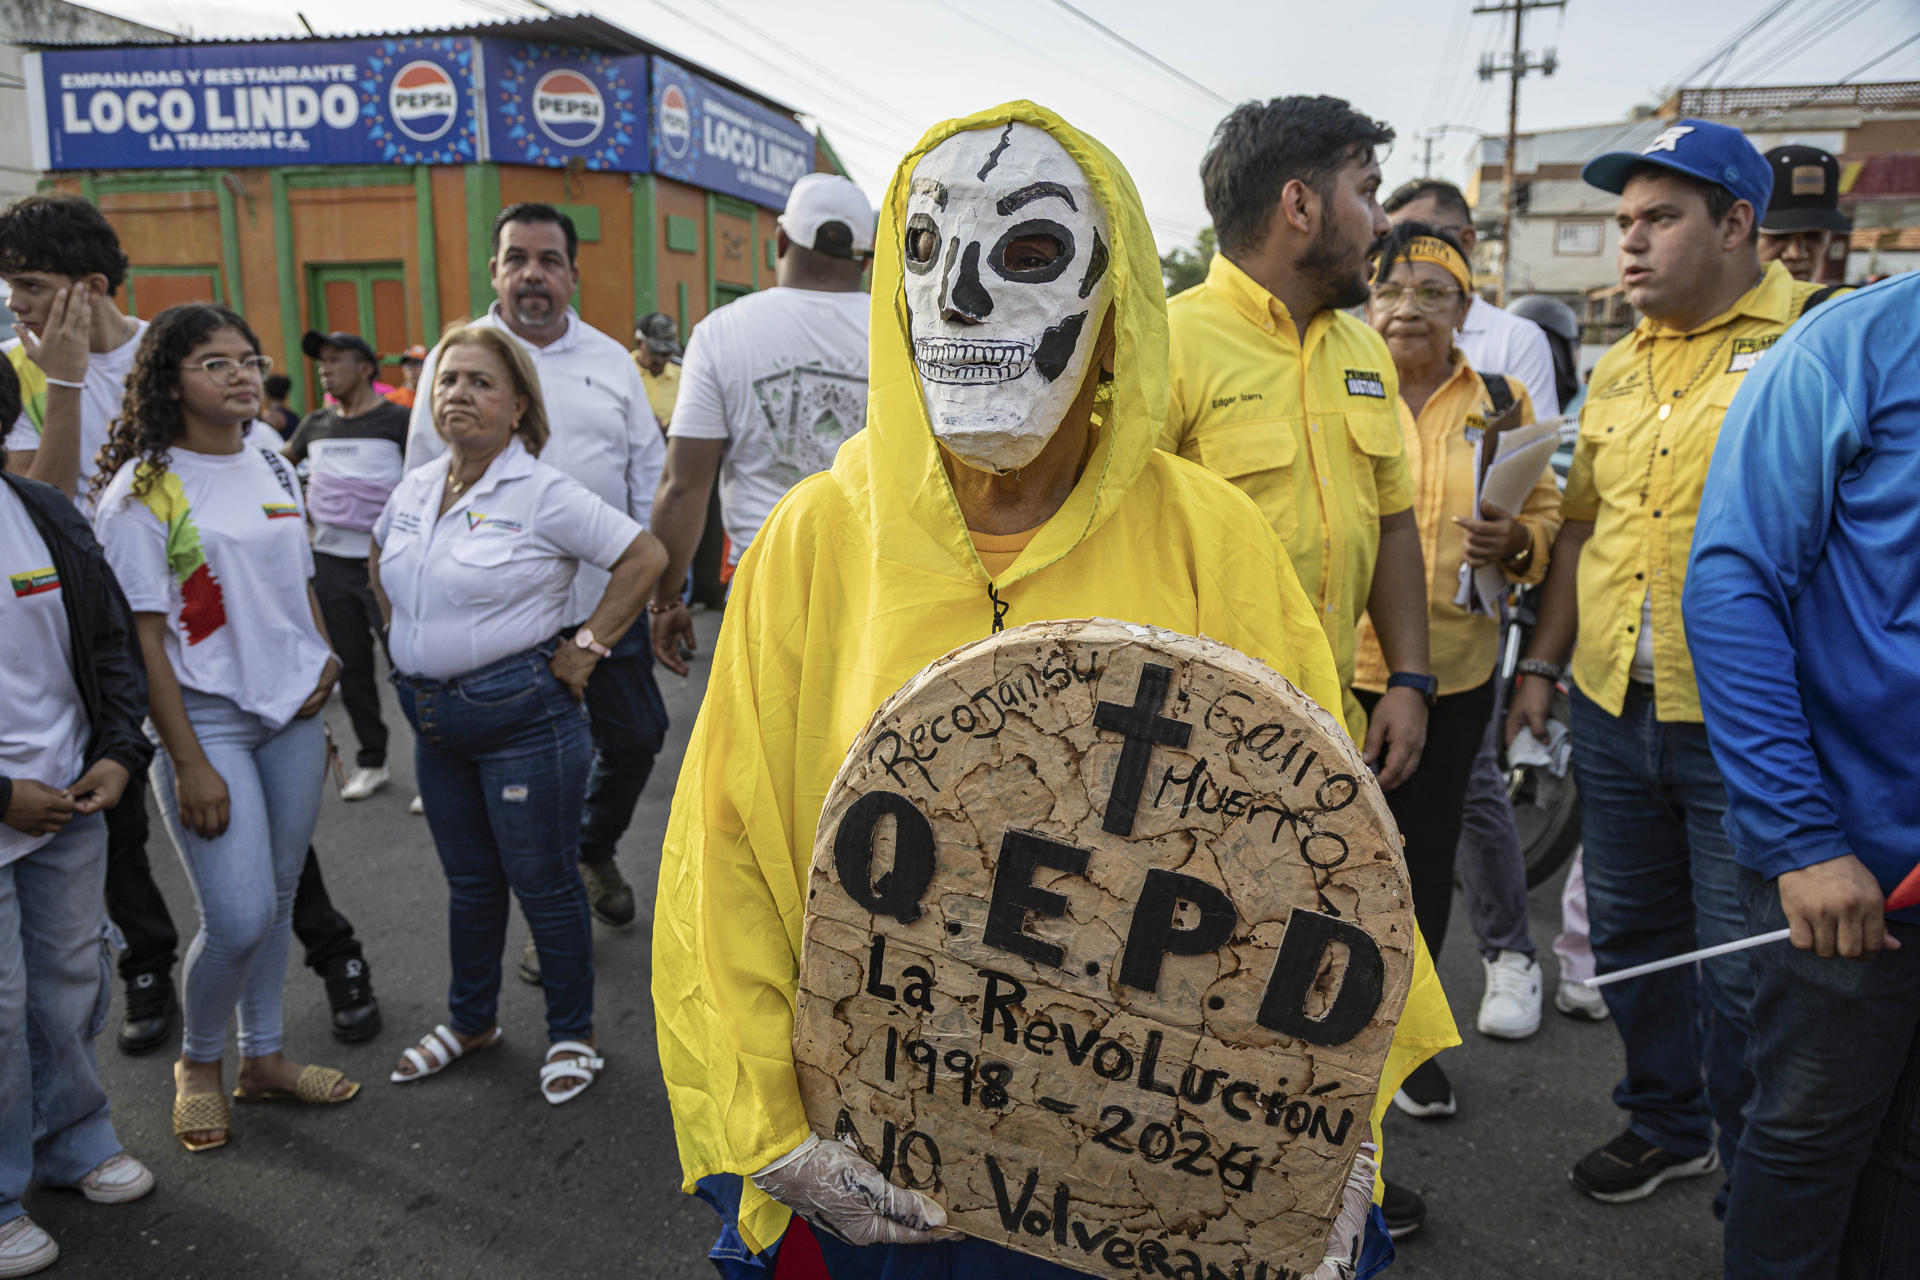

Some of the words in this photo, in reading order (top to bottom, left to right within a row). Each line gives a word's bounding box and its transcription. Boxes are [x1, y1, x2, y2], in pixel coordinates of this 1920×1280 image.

[61, 71, 183, 89] EMPANADAS
[186, 69, 201, 86] Y
[203, 64, 357, 85] RESTAURANTE
[62, 88, 195, 134] LOCO
[203, 83, 359, 131] LINDO
[396, 92, 452, 109] PEPSI
[539, 97, 600, 118] PEPSI
[150, 133, 175, 151] LA
[272, 130, 310, 150] C.A.
[703, 115, 756, 170] LOCO
[1212, 396, 1236, 409] Edgar
[866, 934, 935, 1013] La
[884, 1026, 1014, 1109] 1998
